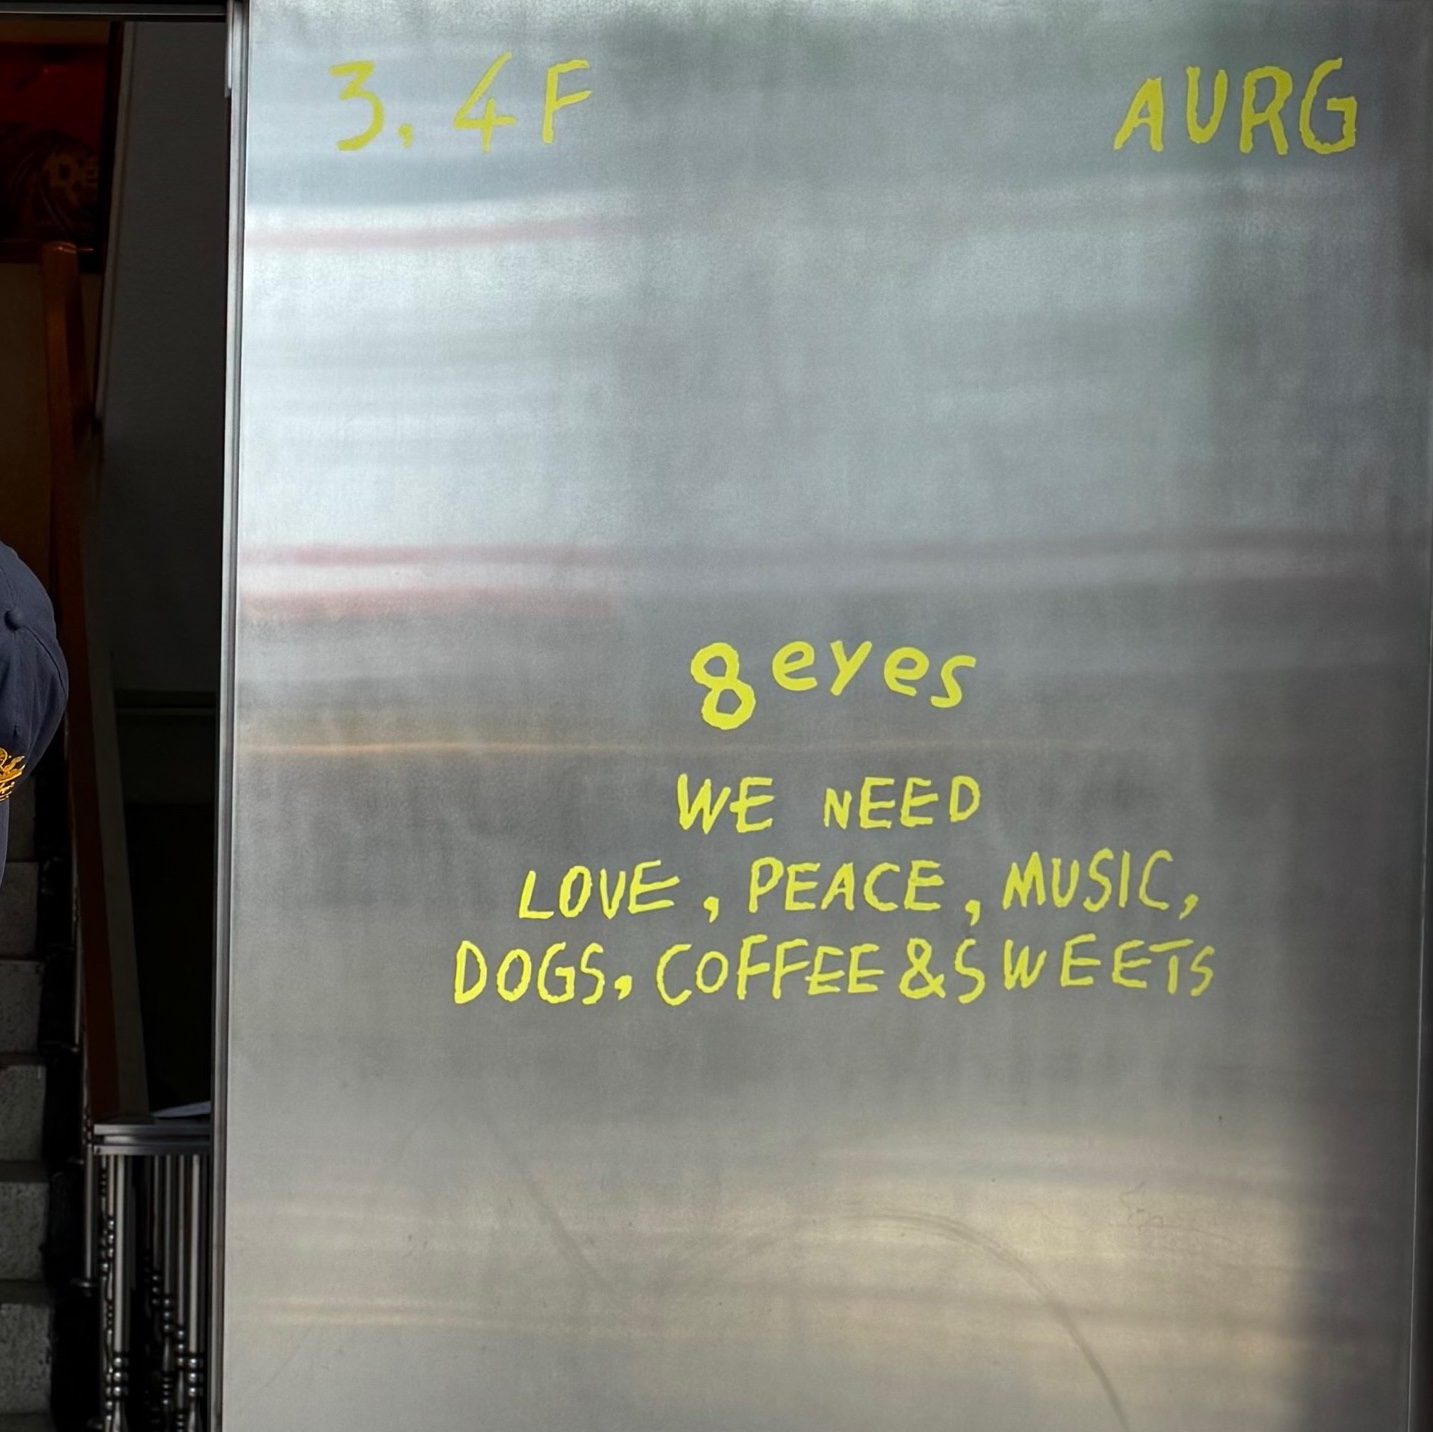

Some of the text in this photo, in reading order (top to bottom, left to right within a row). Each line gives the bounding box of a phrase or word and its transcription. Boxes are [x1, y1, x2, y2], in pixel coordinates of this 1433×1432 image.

[1114, 57, 1358, 156] AURG
[675, 772, 983, 835] WE NEED
